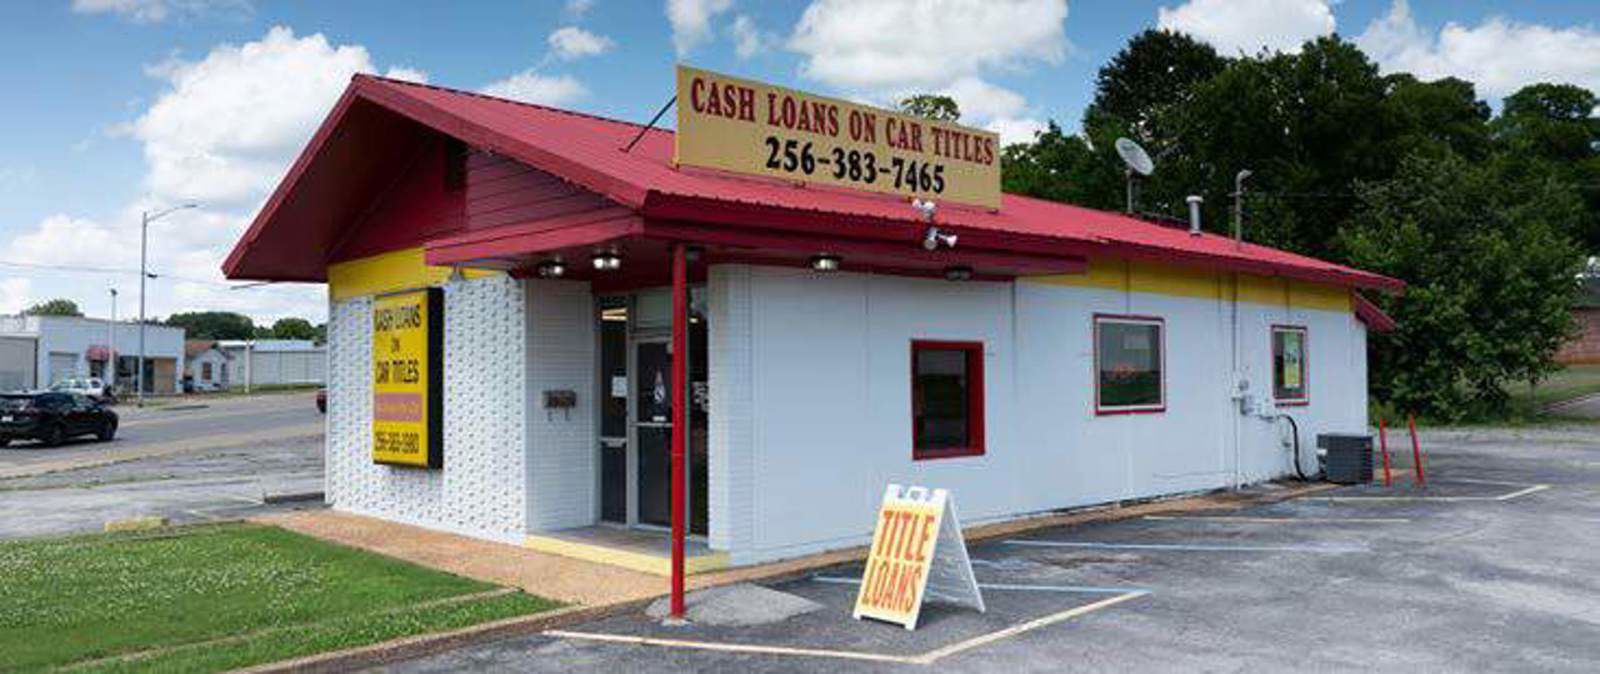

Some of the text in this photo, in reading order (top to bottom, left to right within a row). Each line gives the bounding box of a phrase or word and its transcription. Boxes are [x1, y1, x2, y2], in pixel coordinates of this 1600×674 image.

[690, 77, 995, 166] CASH LOANS ON CAR TITLES
[765, 136, 945, 194] 256-383-7465
[393, 359, 419, 384] TITLES
[876, 510, 935, 563] TITLE
[860, 558, 922, 613] LOANS
